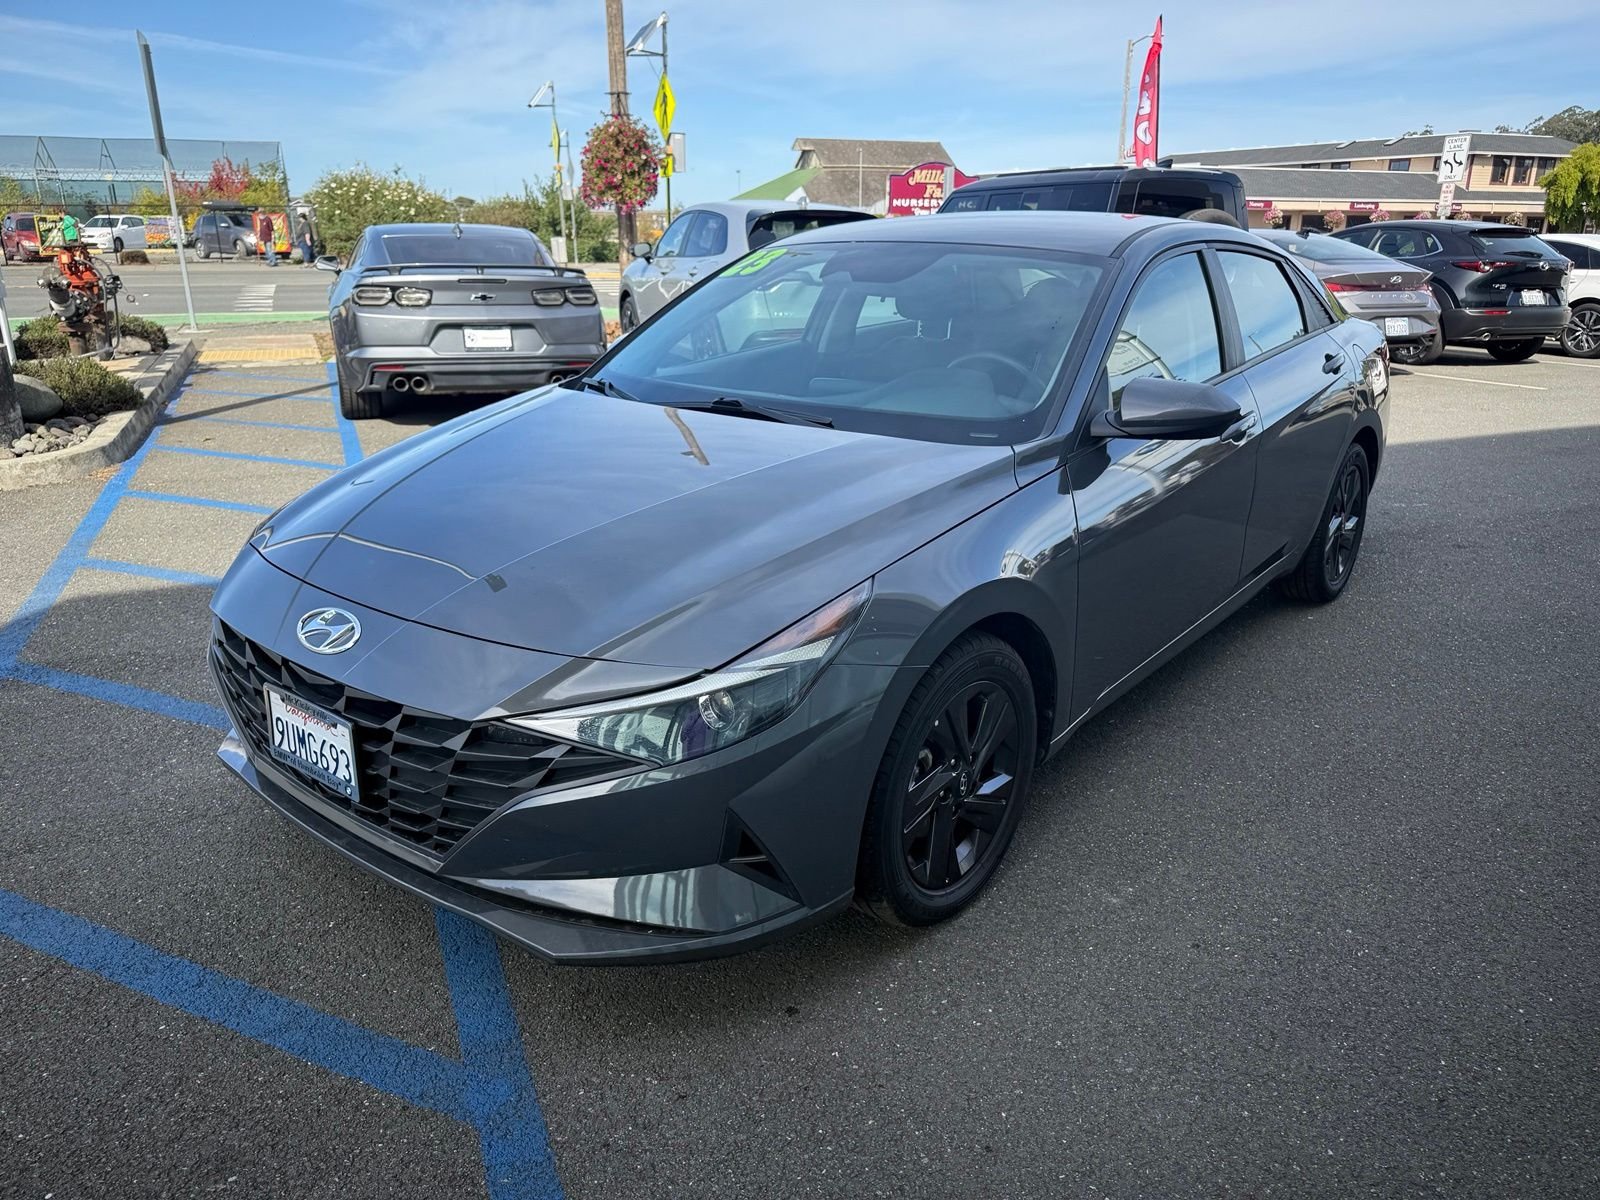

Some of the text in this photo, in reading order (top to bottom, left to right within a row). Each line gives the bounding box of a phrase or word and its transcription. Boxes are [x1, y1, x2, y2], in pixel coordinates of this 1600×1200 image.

[908, 169, 944, 185] Mille
[892, 198, 943, 208] NURSERY
[720, 248, 788, 277] 23
[275, 716, 352, 784] 9UMG693
